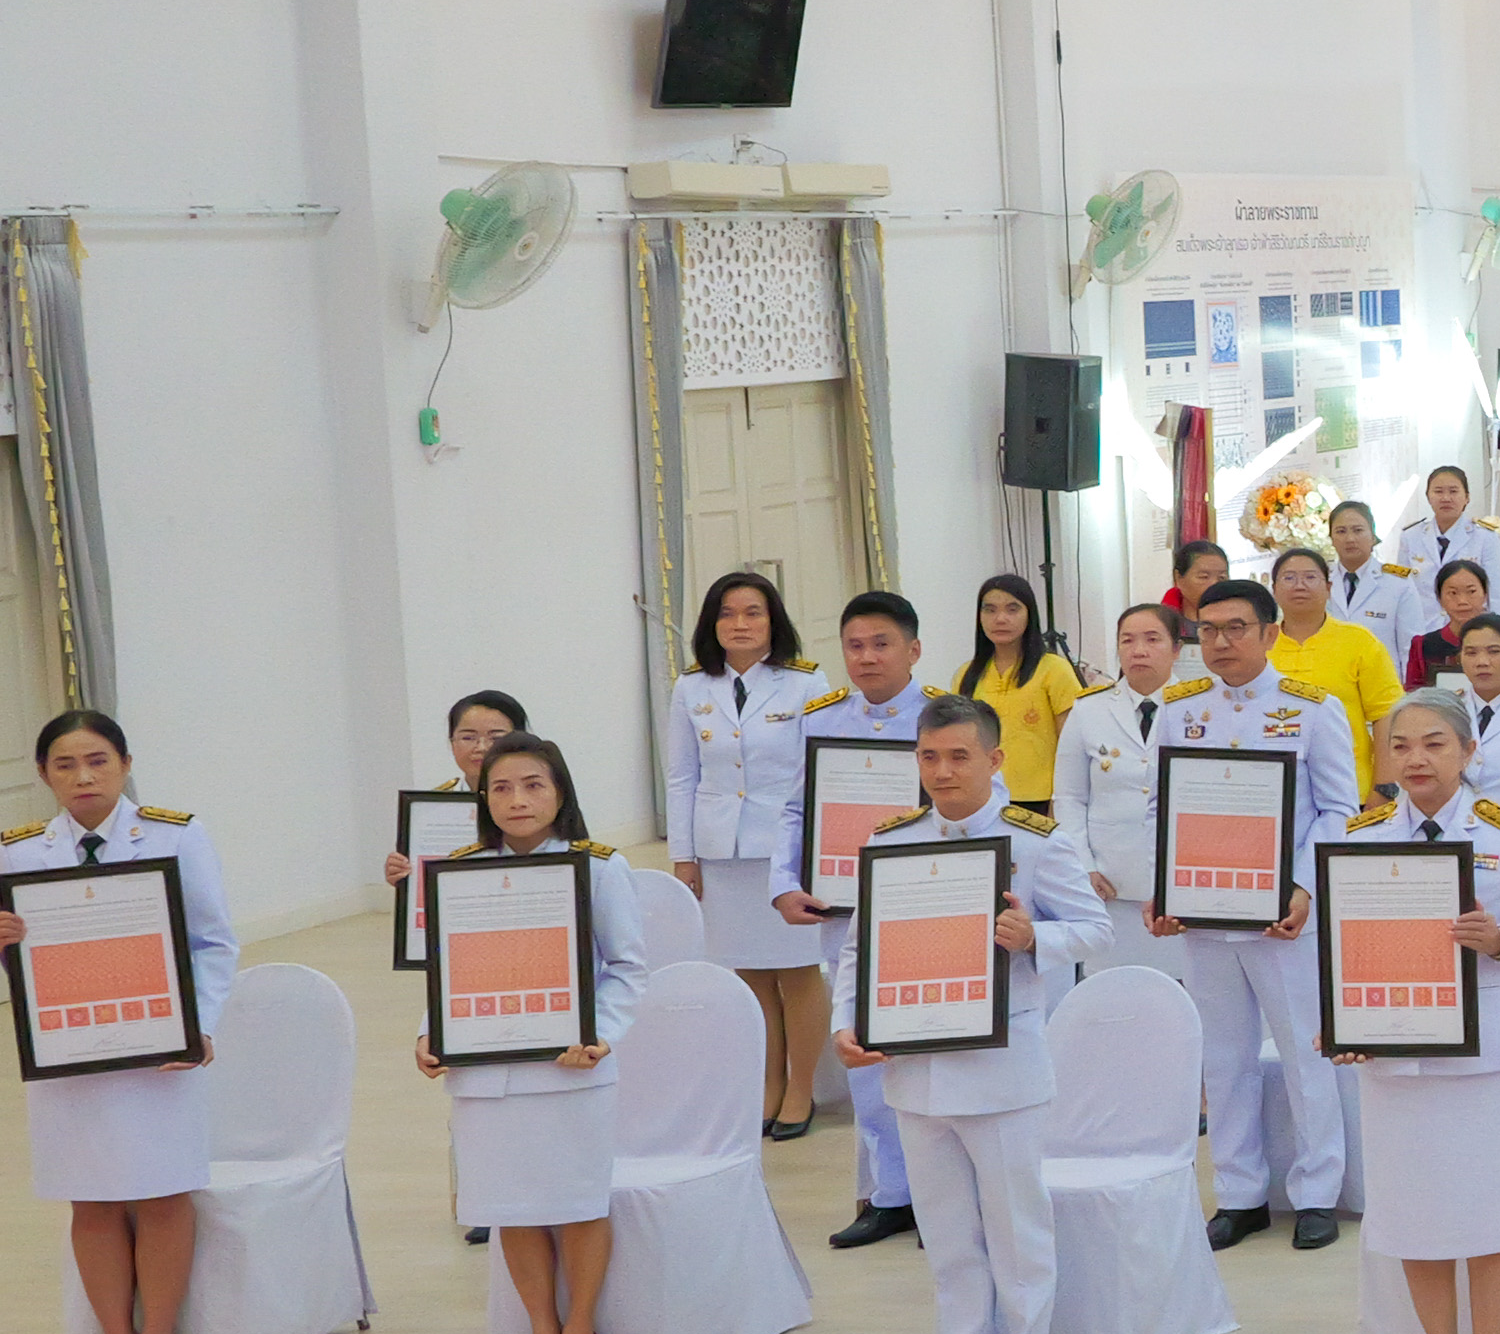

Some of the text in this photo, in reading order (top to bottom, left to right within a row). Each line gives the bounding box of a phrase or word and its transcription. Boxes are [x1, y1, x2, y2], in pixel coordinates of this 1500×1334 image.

[1234, 199, 1319, 221] ผ้าลายพระราชทาน
